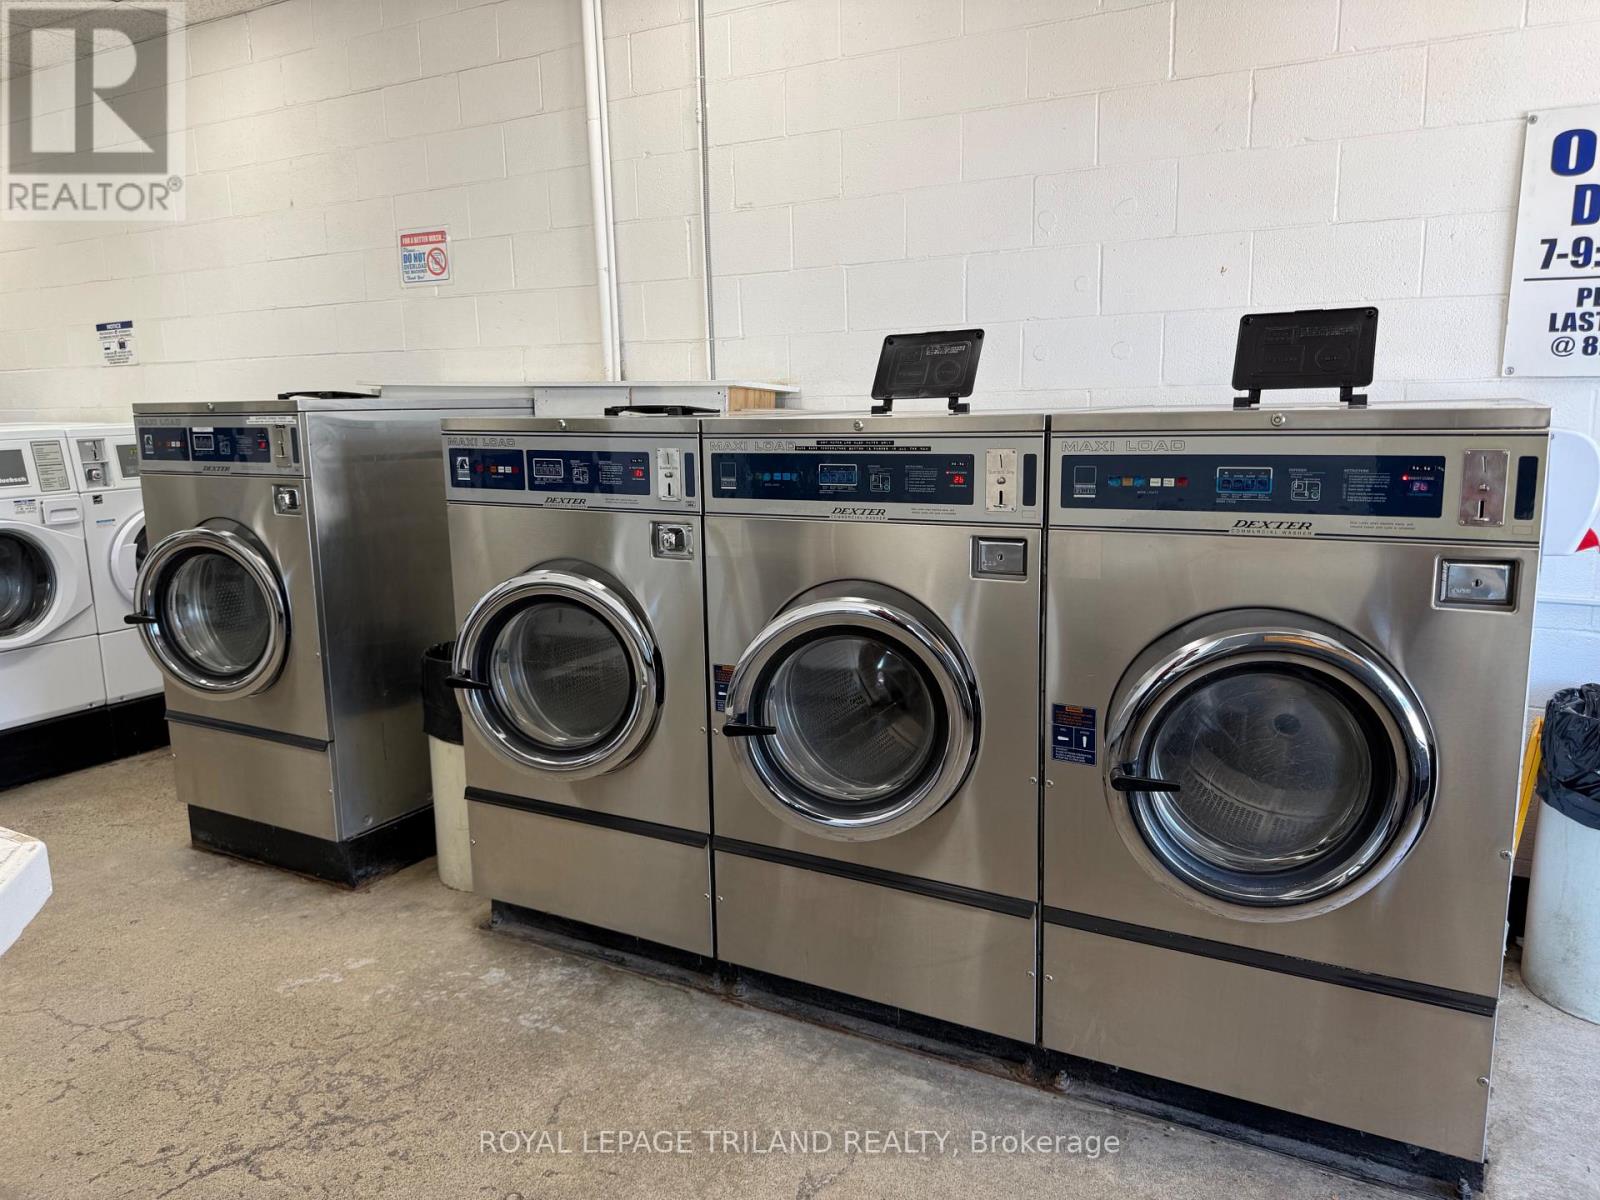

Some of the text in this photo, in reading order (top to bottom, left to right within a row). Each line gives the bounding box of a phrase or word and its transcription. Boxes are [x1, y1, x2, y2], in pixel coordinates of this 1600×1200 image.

[403, 252, 426, 264] DO NOT
[447, 437, 516, 448] MAXI LOAD
[709, 440, 748, 451] MAXI
[754, 440, 796, 452] LOAD
[1061, 439, 1186, 453] MAXI LOAD
[544, 496, 587, 505] DEXTER
[831, 507, 887, 516] DEXTER
[1232, 519, 1314, 531] DEXTER
[1230, 528, 1278, 536] COMMERCIAL
